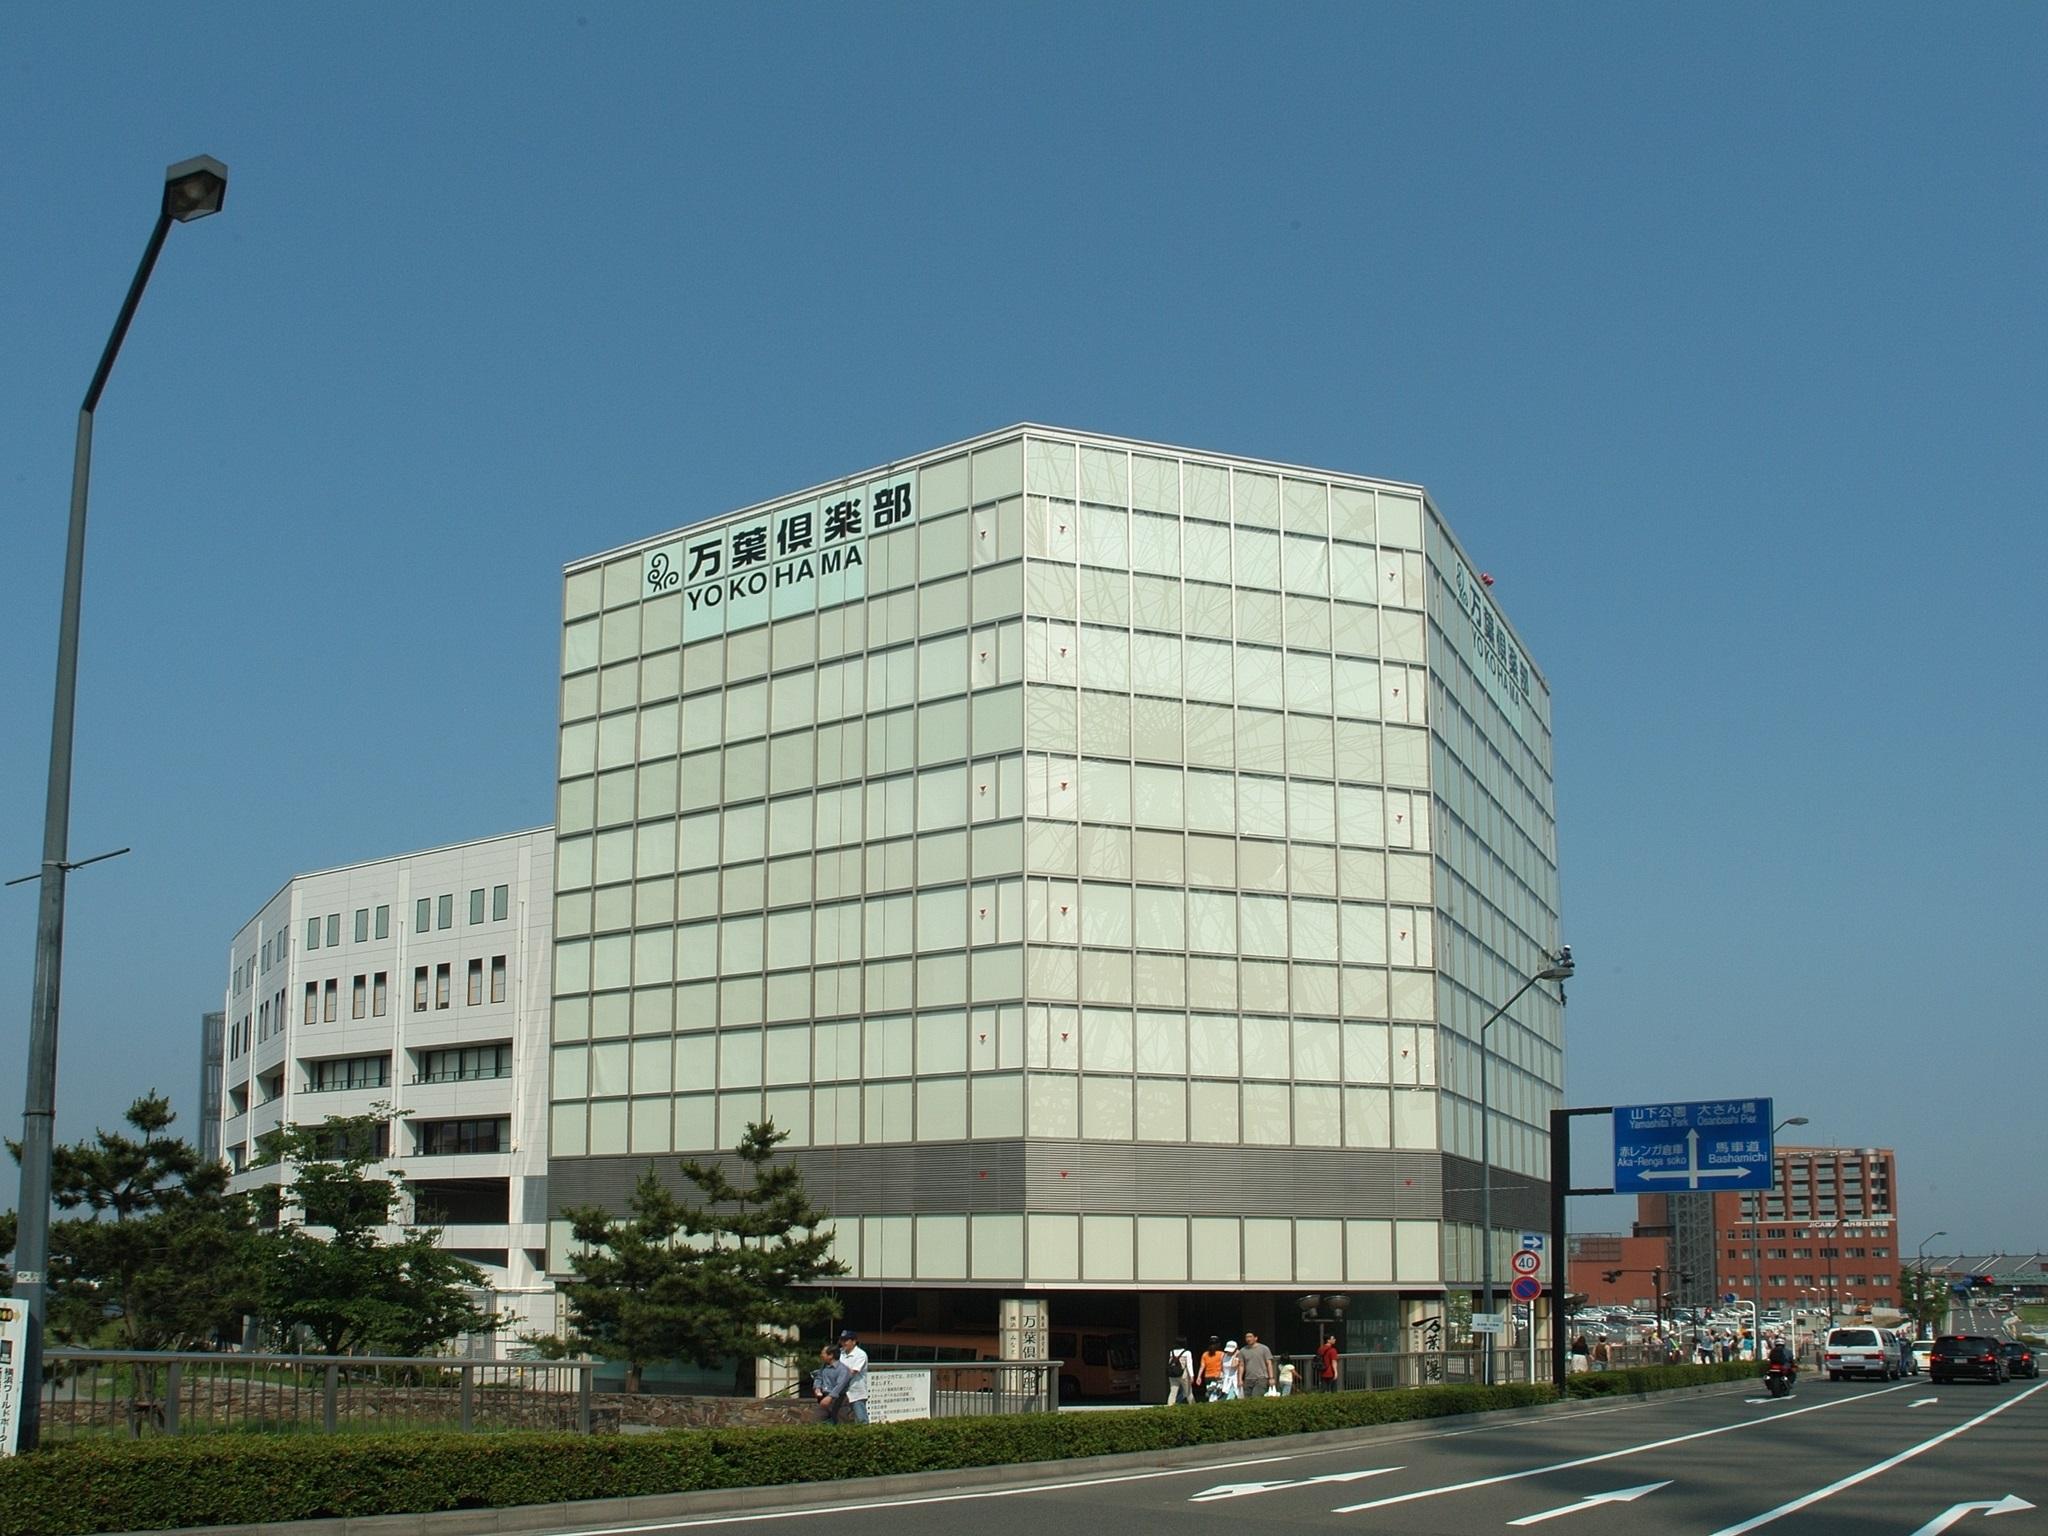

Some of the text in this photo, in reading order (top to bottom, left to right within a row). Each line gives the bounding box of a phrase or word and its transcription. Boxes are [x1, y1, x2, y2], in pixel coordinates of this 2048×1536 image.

[688, 482, 912, 582] 万葉倶楽部
[687, 545, 863, 611] YOKOHAMA
[1631, 1106, 1687, 1120] 山下公園
[1671, 1117, 1688, 1128] Park
[1708, 1152, 1768, 1164] Bashamichi
[1518, 1257, 1535, 1269] 40
